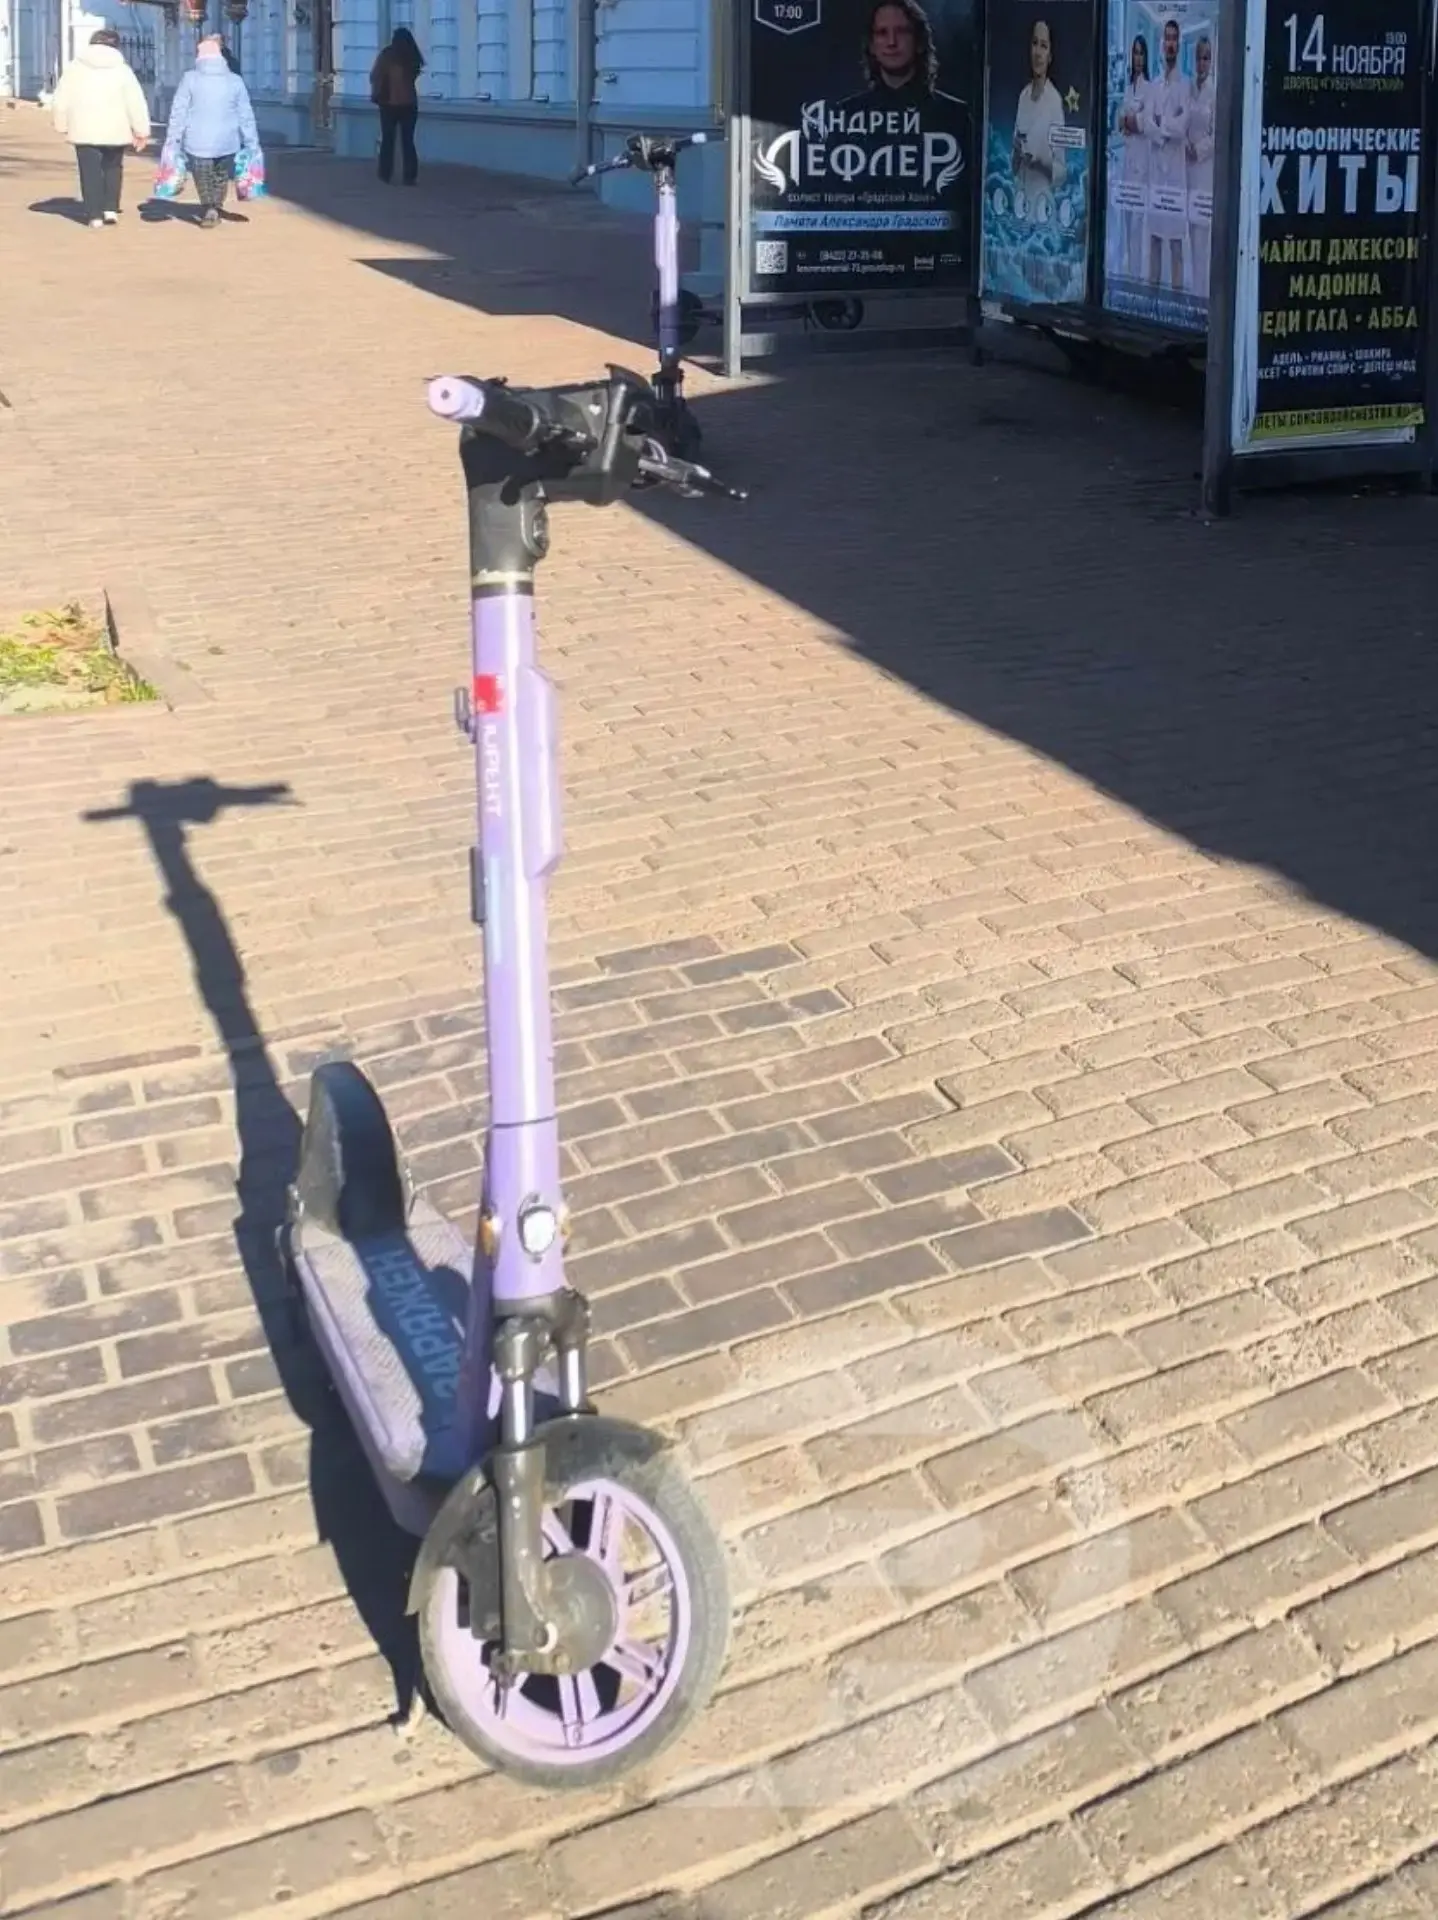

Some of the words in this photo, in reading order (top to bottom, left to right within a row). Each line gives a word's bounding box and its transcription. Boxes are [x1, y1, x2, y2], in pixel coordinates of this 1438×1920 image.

[774, 4, 803, 19] 17:00
[1284, 13, 1327, 73] 14
[1332, 44, 1406, 76] НОЯБРЯ
[753, 130, 965, 196] ЛЕФЛЕР
[1260, 155, 1420, 214] ХИТЫ
[1327, 237, 1420, 265] ДЖЕКСОН
[1288, 272, 1383, 301] МАДОННА
[1258, 309, 1301, 338] ЕДИ
[1306, 307, 1349, 332] ГАГА
[1367, 306, 1420, 330] АББА
